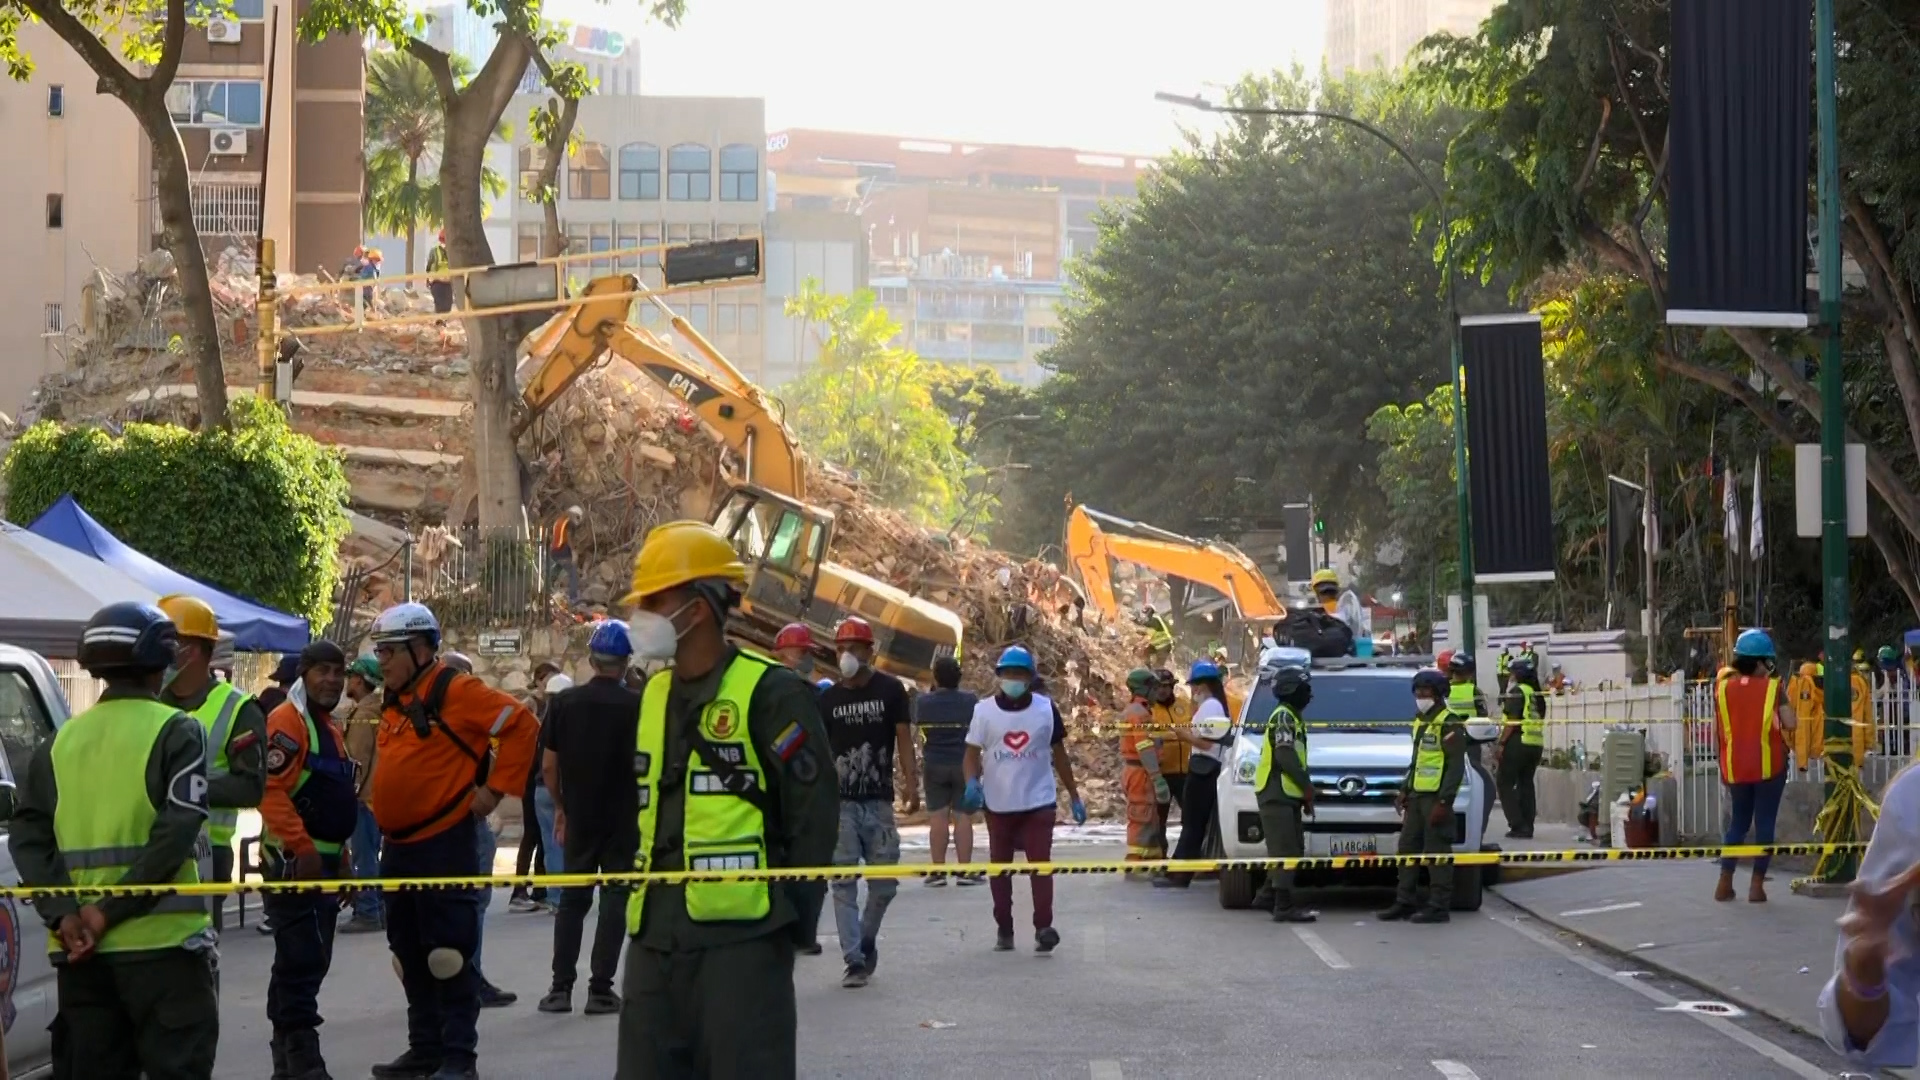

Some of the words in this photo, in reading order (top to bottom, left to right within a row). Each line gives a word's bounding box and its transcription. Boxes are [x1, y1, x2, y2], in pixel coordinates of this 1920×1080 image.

[669, 372, 699, 401] CAT
[833, 699, 885, 719] CALIFORNIA
[712, 746, 740, 762] NB
[190, 774, 208, 803] P
